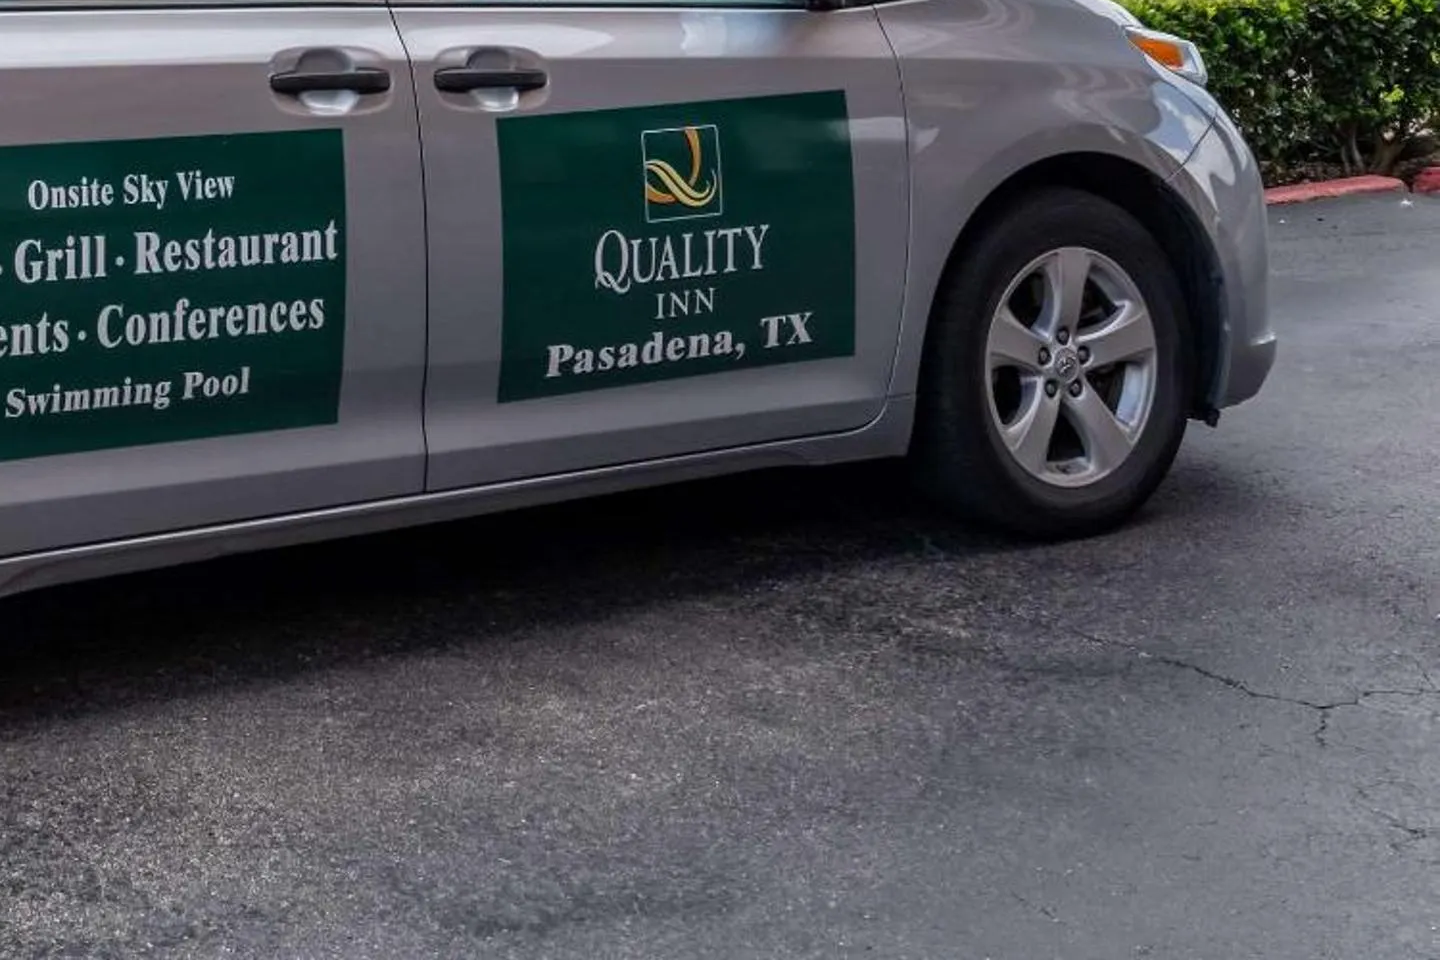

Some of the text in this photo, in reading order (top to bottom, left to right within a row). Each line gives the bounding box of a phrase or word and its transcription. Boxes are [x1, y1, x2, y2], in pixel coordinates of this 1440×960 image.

[27, 169, 236, 211] Onsite Sky View
[133, 219, 339, 275] Restaurant
[594, 224, 771, 294] QUALITY
[96, 296, 325, 349] Conferences
[654, 287, 716, 320] INN
[543, 311, 814, 379] Pasadena, TX
[4, 366, 250, 419] Swimming Pool
